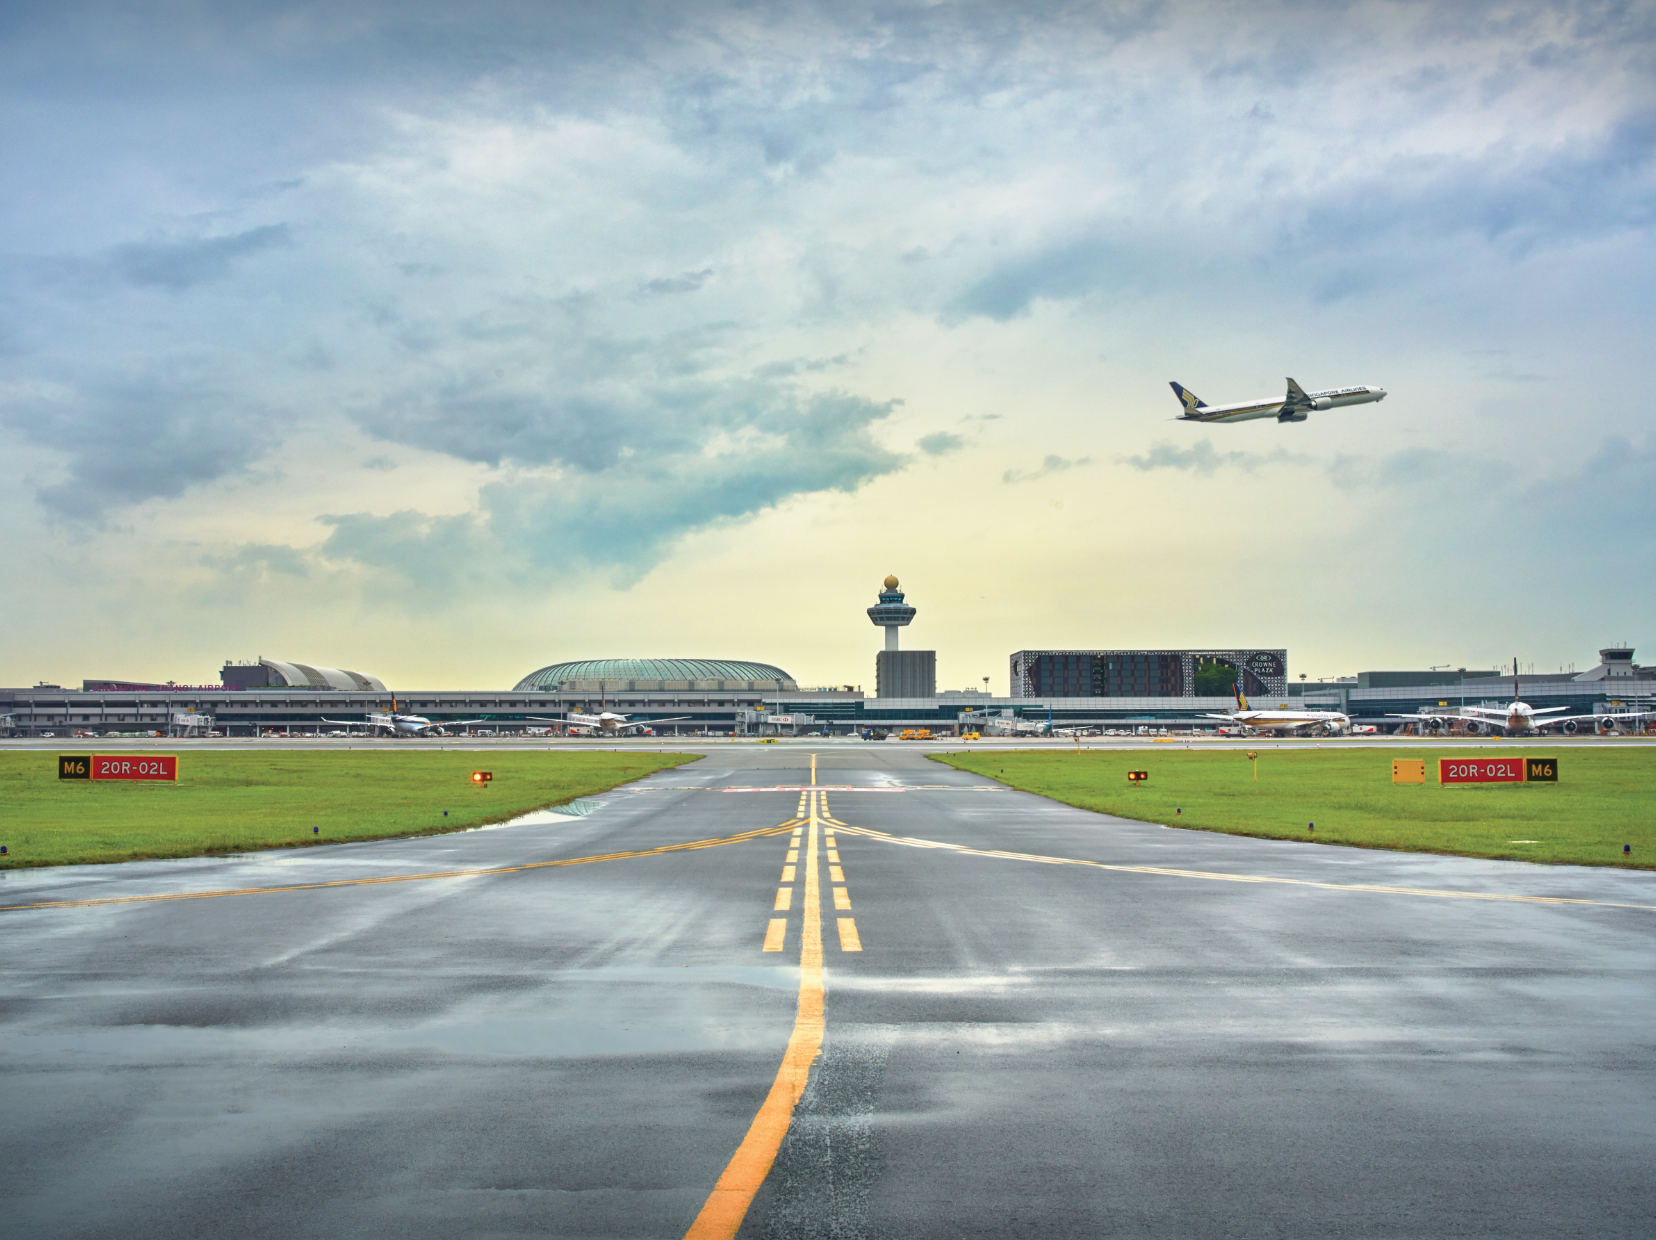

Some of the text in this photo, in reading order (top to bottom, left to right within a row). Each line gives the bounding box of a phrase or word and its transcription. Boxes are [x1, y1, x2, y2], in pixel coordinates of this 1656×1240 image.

[92, 684, 241, 692] SINGAPORE CHANGI AIRPORT
[64, 761, 85, 774] M6
[101, 761, 168, 775] 20R-02L
[1448, 764, 1516, 778] 20R-02L
[1531, 764, 1553, 777] M6
